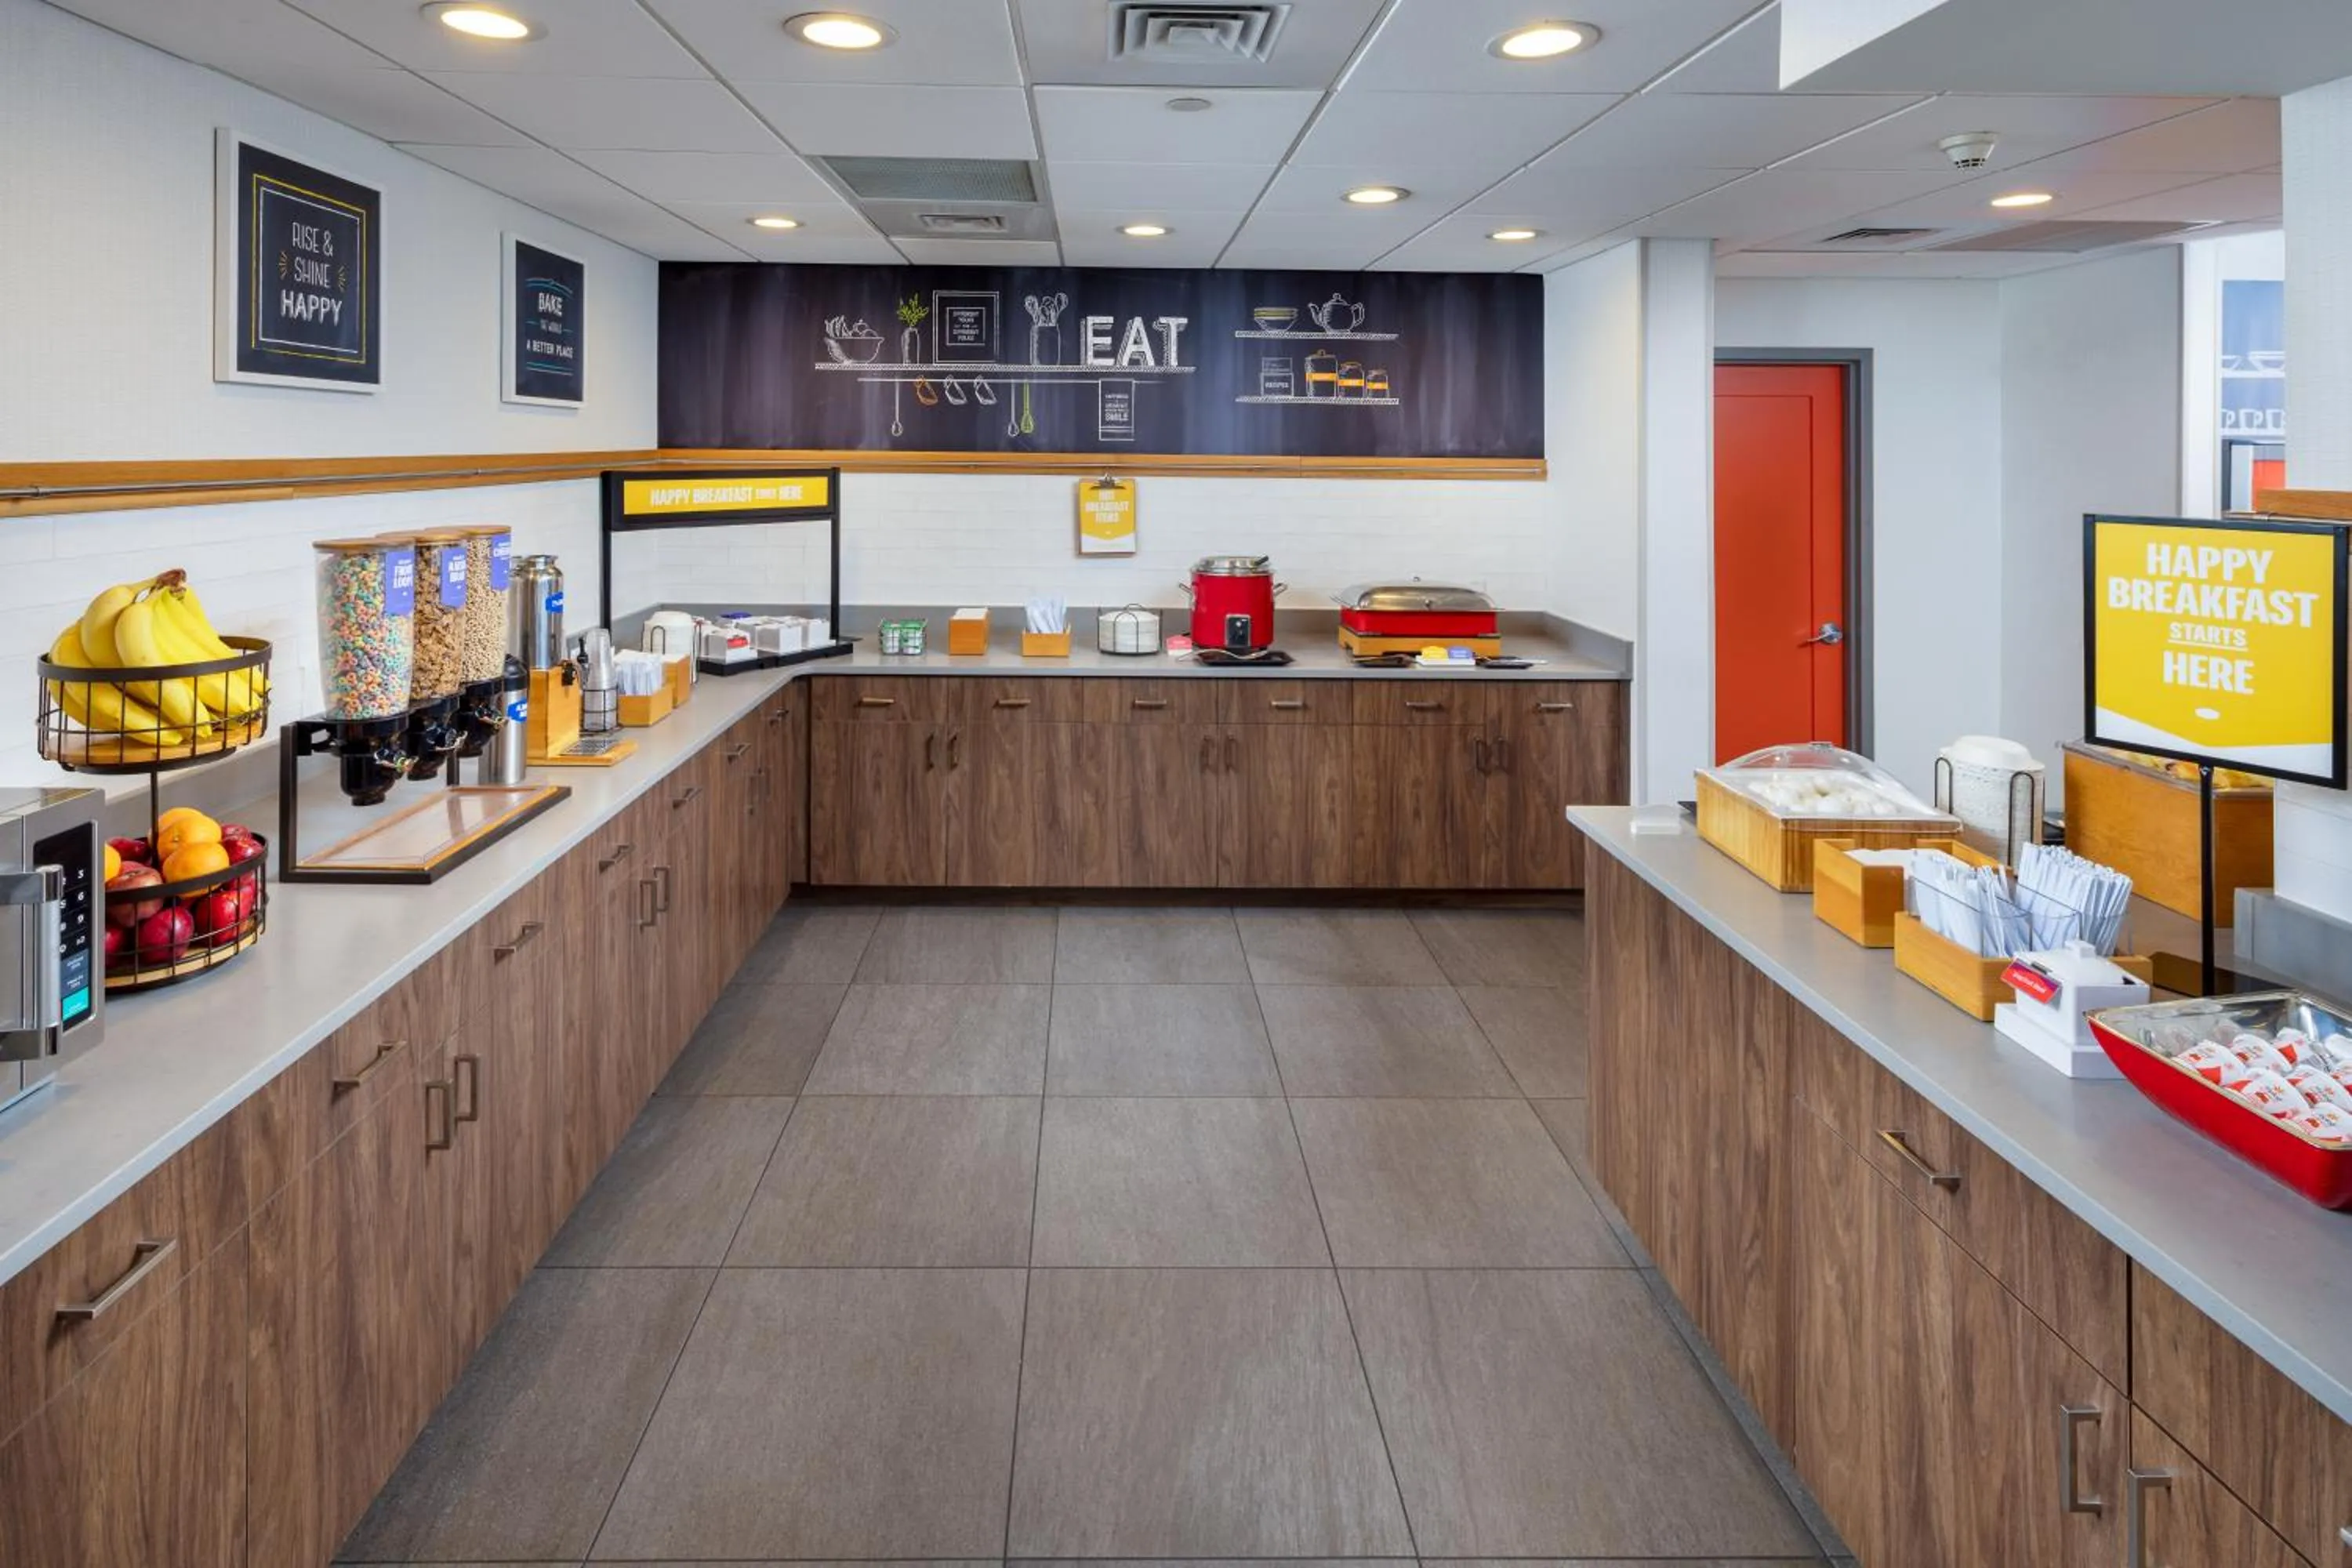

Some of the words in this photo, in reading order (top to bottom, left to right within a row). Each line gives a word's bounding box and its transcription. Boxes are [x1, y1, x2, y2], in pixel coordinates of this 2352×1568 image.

[292, 222, 319, 253] RISE
[323, 230, 333, 256] &
[294, 256, 331, 289] SHINE
[281, 289, 343, 326] HAPPY
[539, 292, 563, 317] BAKE
[532, 339, 554, 354] BETTER
[556, 345, 573, 359] PLACE
[1081, 316, 1189, 366] EAT
[651, 488, 690, 506] HAPPY
[693, 486, 753, 503] BREAKFAST
[779, 485, 804, 500] HERE
[2147, 543, 2274, 583] HAPPY
[2107, 576, 2319, 628] BREAKFAST
[2169, 622, 2247, 648] STARTS
[2163, 650, 2255, 695] HERE
[78, 891, 84, 901] 6
